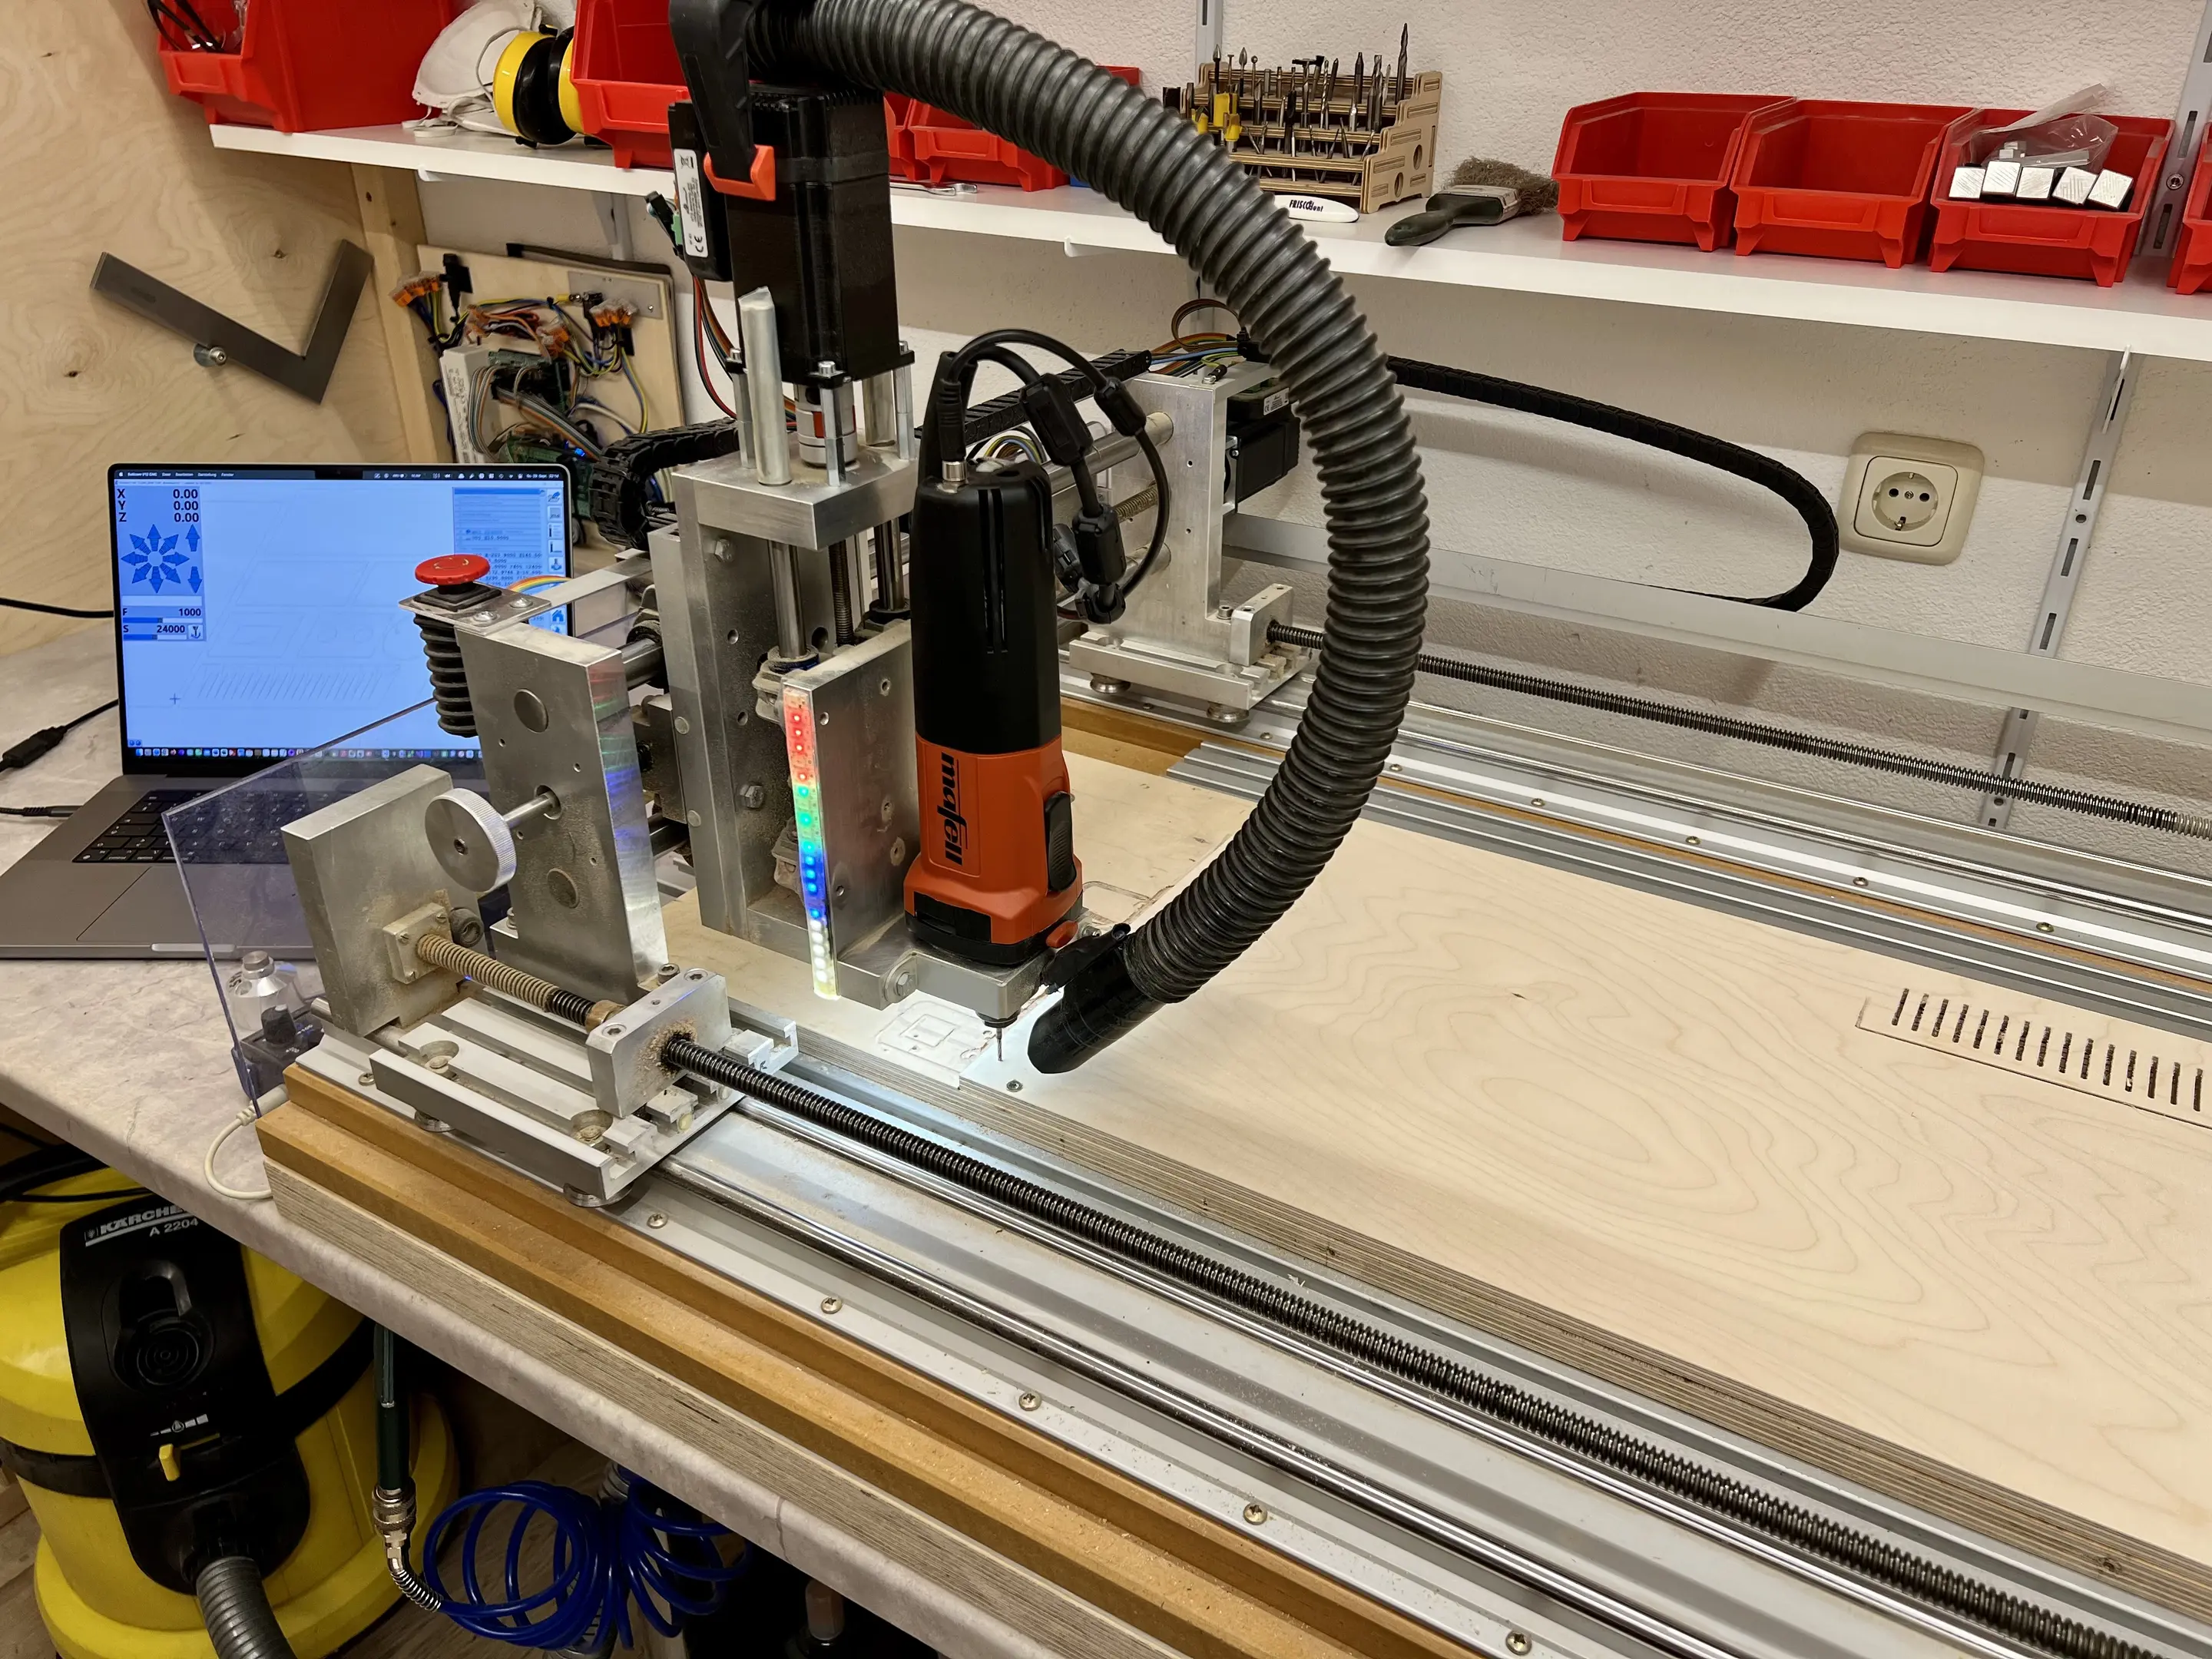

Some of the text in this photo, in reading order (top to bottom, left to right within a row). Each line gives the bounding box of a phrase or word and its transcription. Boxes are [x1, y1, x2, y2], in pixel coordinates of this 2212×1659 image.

[117, 488, 198, 499] X 0.00
[118, 501, 199, 511] Y 0.00
[119, 512, 200, 522] Z 0.00
[178, 608, 201, 617] 1000
[157, 625, 185, 634] 24000
[937, 751, 968, 866] mafell
[100, 1205, 185, 1235] KÄRCHE
[149, 1217, 199, 1237] A 2204
